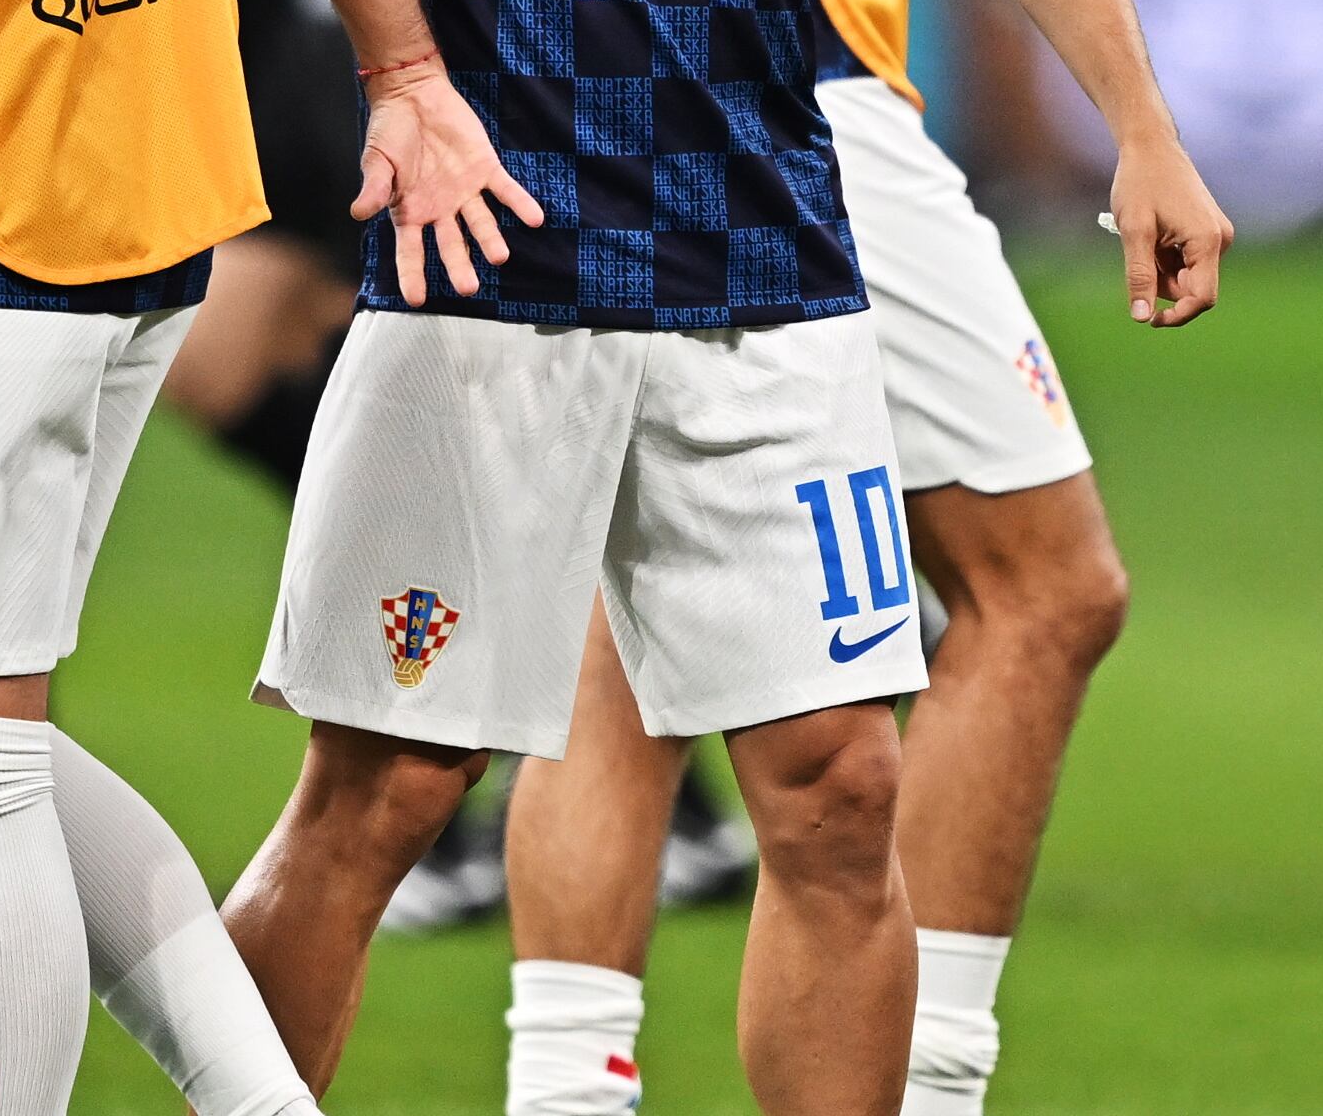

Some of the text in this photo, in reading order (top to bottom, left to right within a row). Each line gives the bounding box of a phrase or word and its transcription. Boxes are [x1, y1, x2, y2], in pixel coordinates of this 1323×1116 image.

[498, 12, 573, 29] HRVATSKA
[499, 28, 573, 45] HRVATSKA
[499, 43, 573, 61] HRVATSKA
[499, 59, 574, 77] HRVATSKA
[575, 77, 652, 93] HRVATSKA
[575, 93, 652, 109] HRVATSKA
[575, 109, 653, 124] HRVATSKA
[575, 125, 653, 140] HRVATSKA
[575, 141, 653, 156] HRVATSKA
[653, 152, 726, 170] HRVATSKA
[653, 168, 726, 185] HRVATSKA
[653, 184, 727, 200] HRVATSKA
[652, 200, 727, 216] HRVATSKA
[652, 216, 727, 231] HRVATSKA
[578, 229, 653, 245] HRVATSKA
[728, 227, 796, 245] HRVATSKA
[578, 245, 653, 261] HRVATSKA
[728, 242, 797, 260] HRVATSKA
[578, 261, 653, 277] HRVATSKA
[728, 258, 799, 276] HRVATSKA
[578, 277, 653, 293] HRVATSKA
[728, 273, 800, 292] HRVATSKA
[578, 293, 653, 309] HRVATSKA
[728, 288, 801, 307] HRVATSKA
[802, 295, 863, 315] HRVATSKA
[498, 300, 577, 319] HRVATSKA
[654, 306, 730, 323] HRVATSKA
[795, 465, 911, 621] 10
[410, 597, 427, 649] HNS
